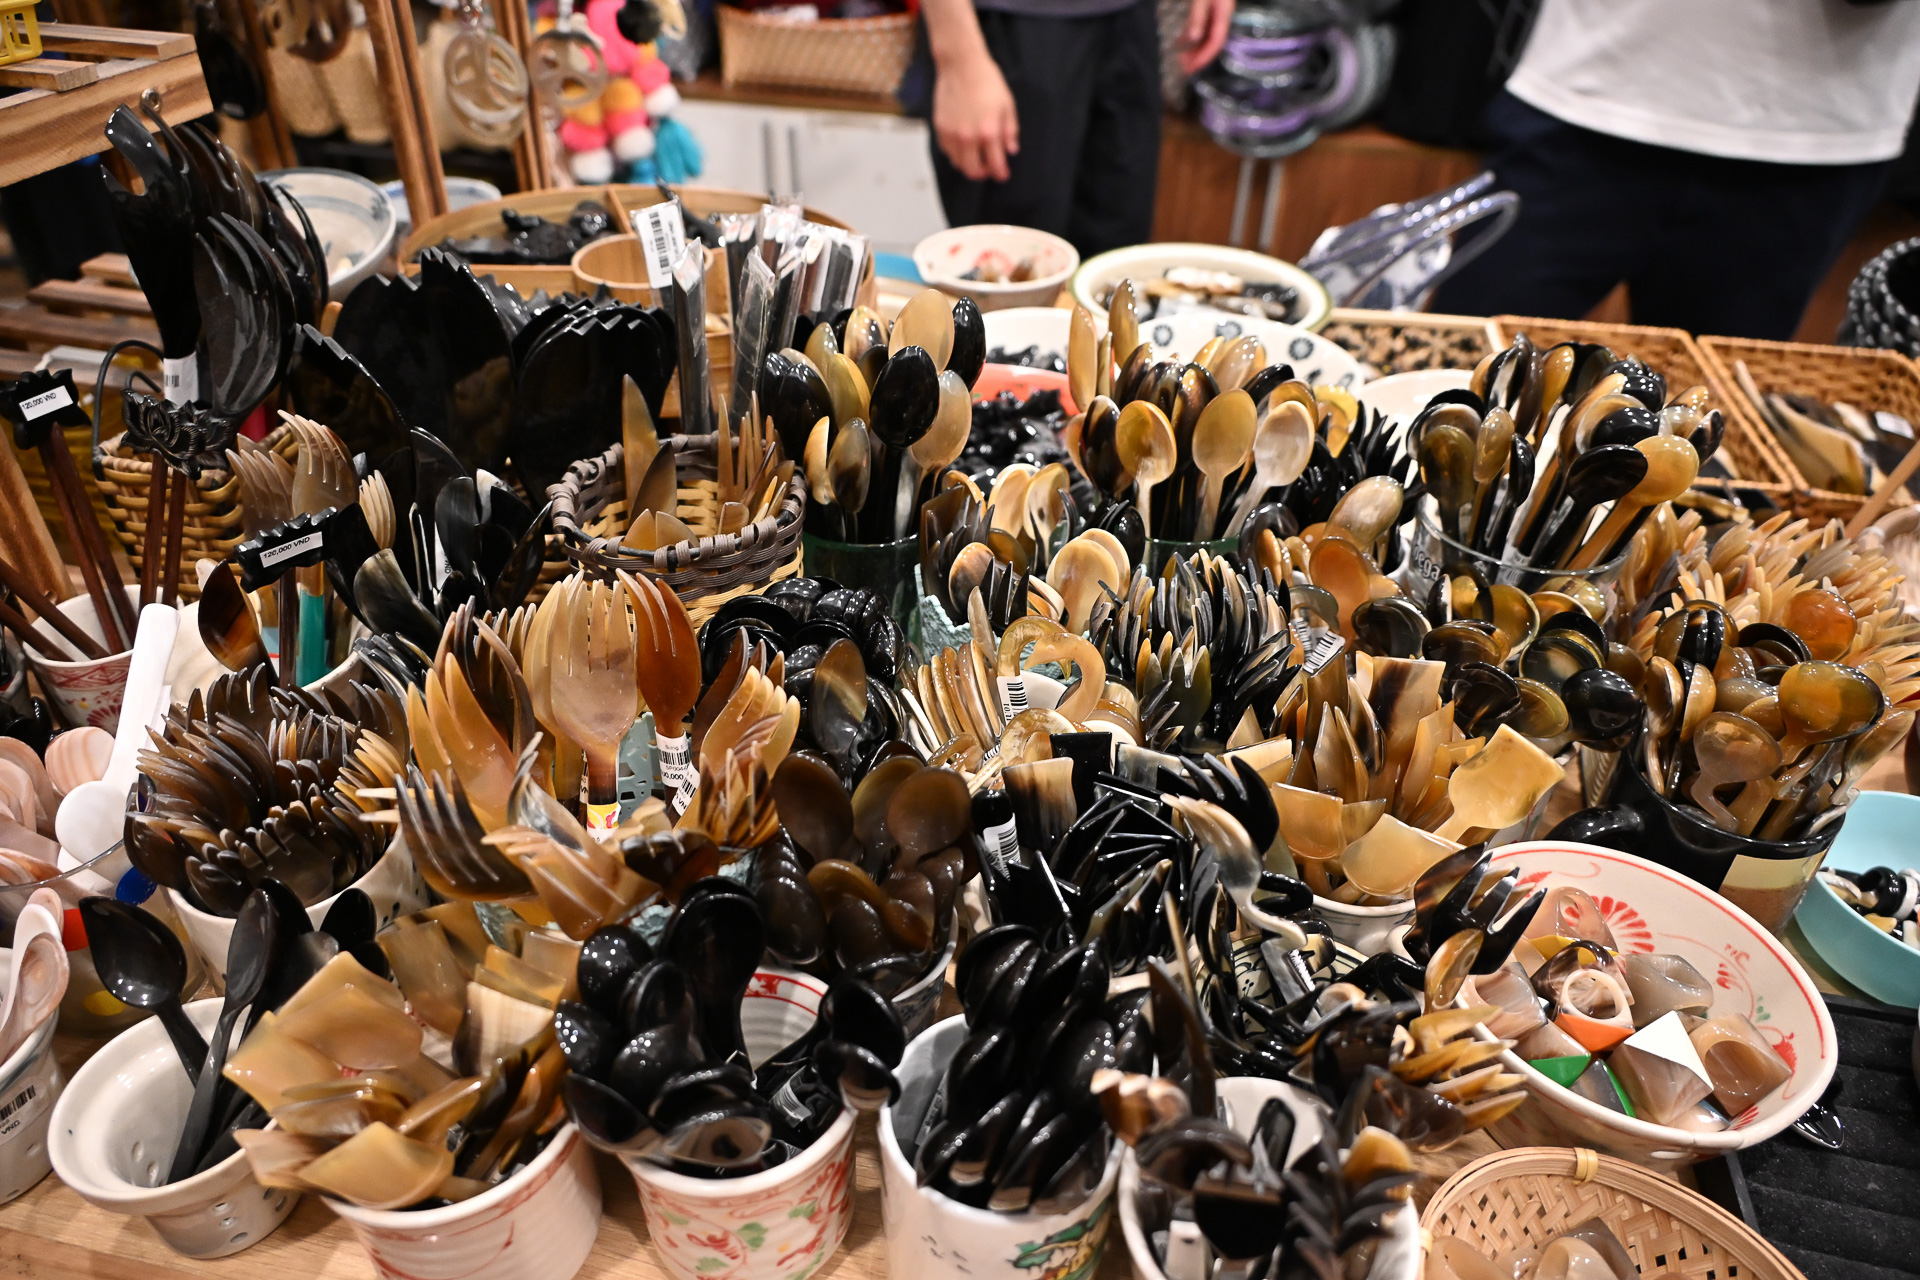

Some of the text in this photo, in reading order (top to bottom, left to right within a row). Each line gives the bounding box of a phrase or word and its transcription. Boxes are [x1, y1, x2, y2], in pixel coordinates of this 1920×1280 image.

[43, 392, 56, 402] VND
[263, 536, 311, 558] 120,000 VND
[1, 1120, 20, 1134] VND
